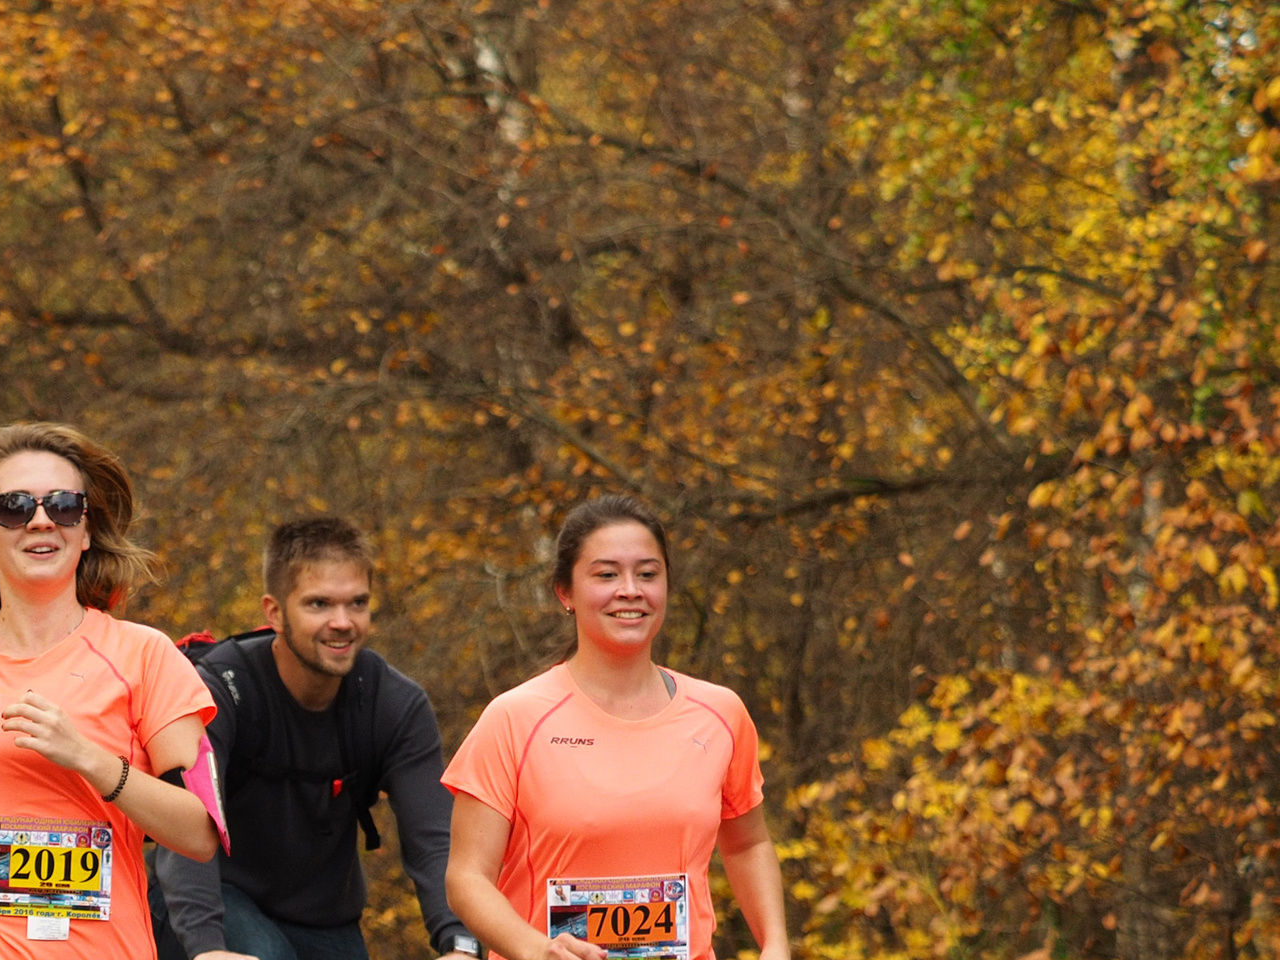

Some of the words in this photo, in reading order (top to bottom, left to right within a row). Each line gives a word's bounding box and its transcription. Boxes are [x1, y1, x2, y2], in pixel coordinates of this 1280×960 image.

[550, 737, 595, 745] RRUNS
[54, 825, 88, 833] МАРАФОН
[11, 848, 99, 883] 2019
[66, 911, 100, 919] Королёв
[589, 903, 673, 937] 7024
